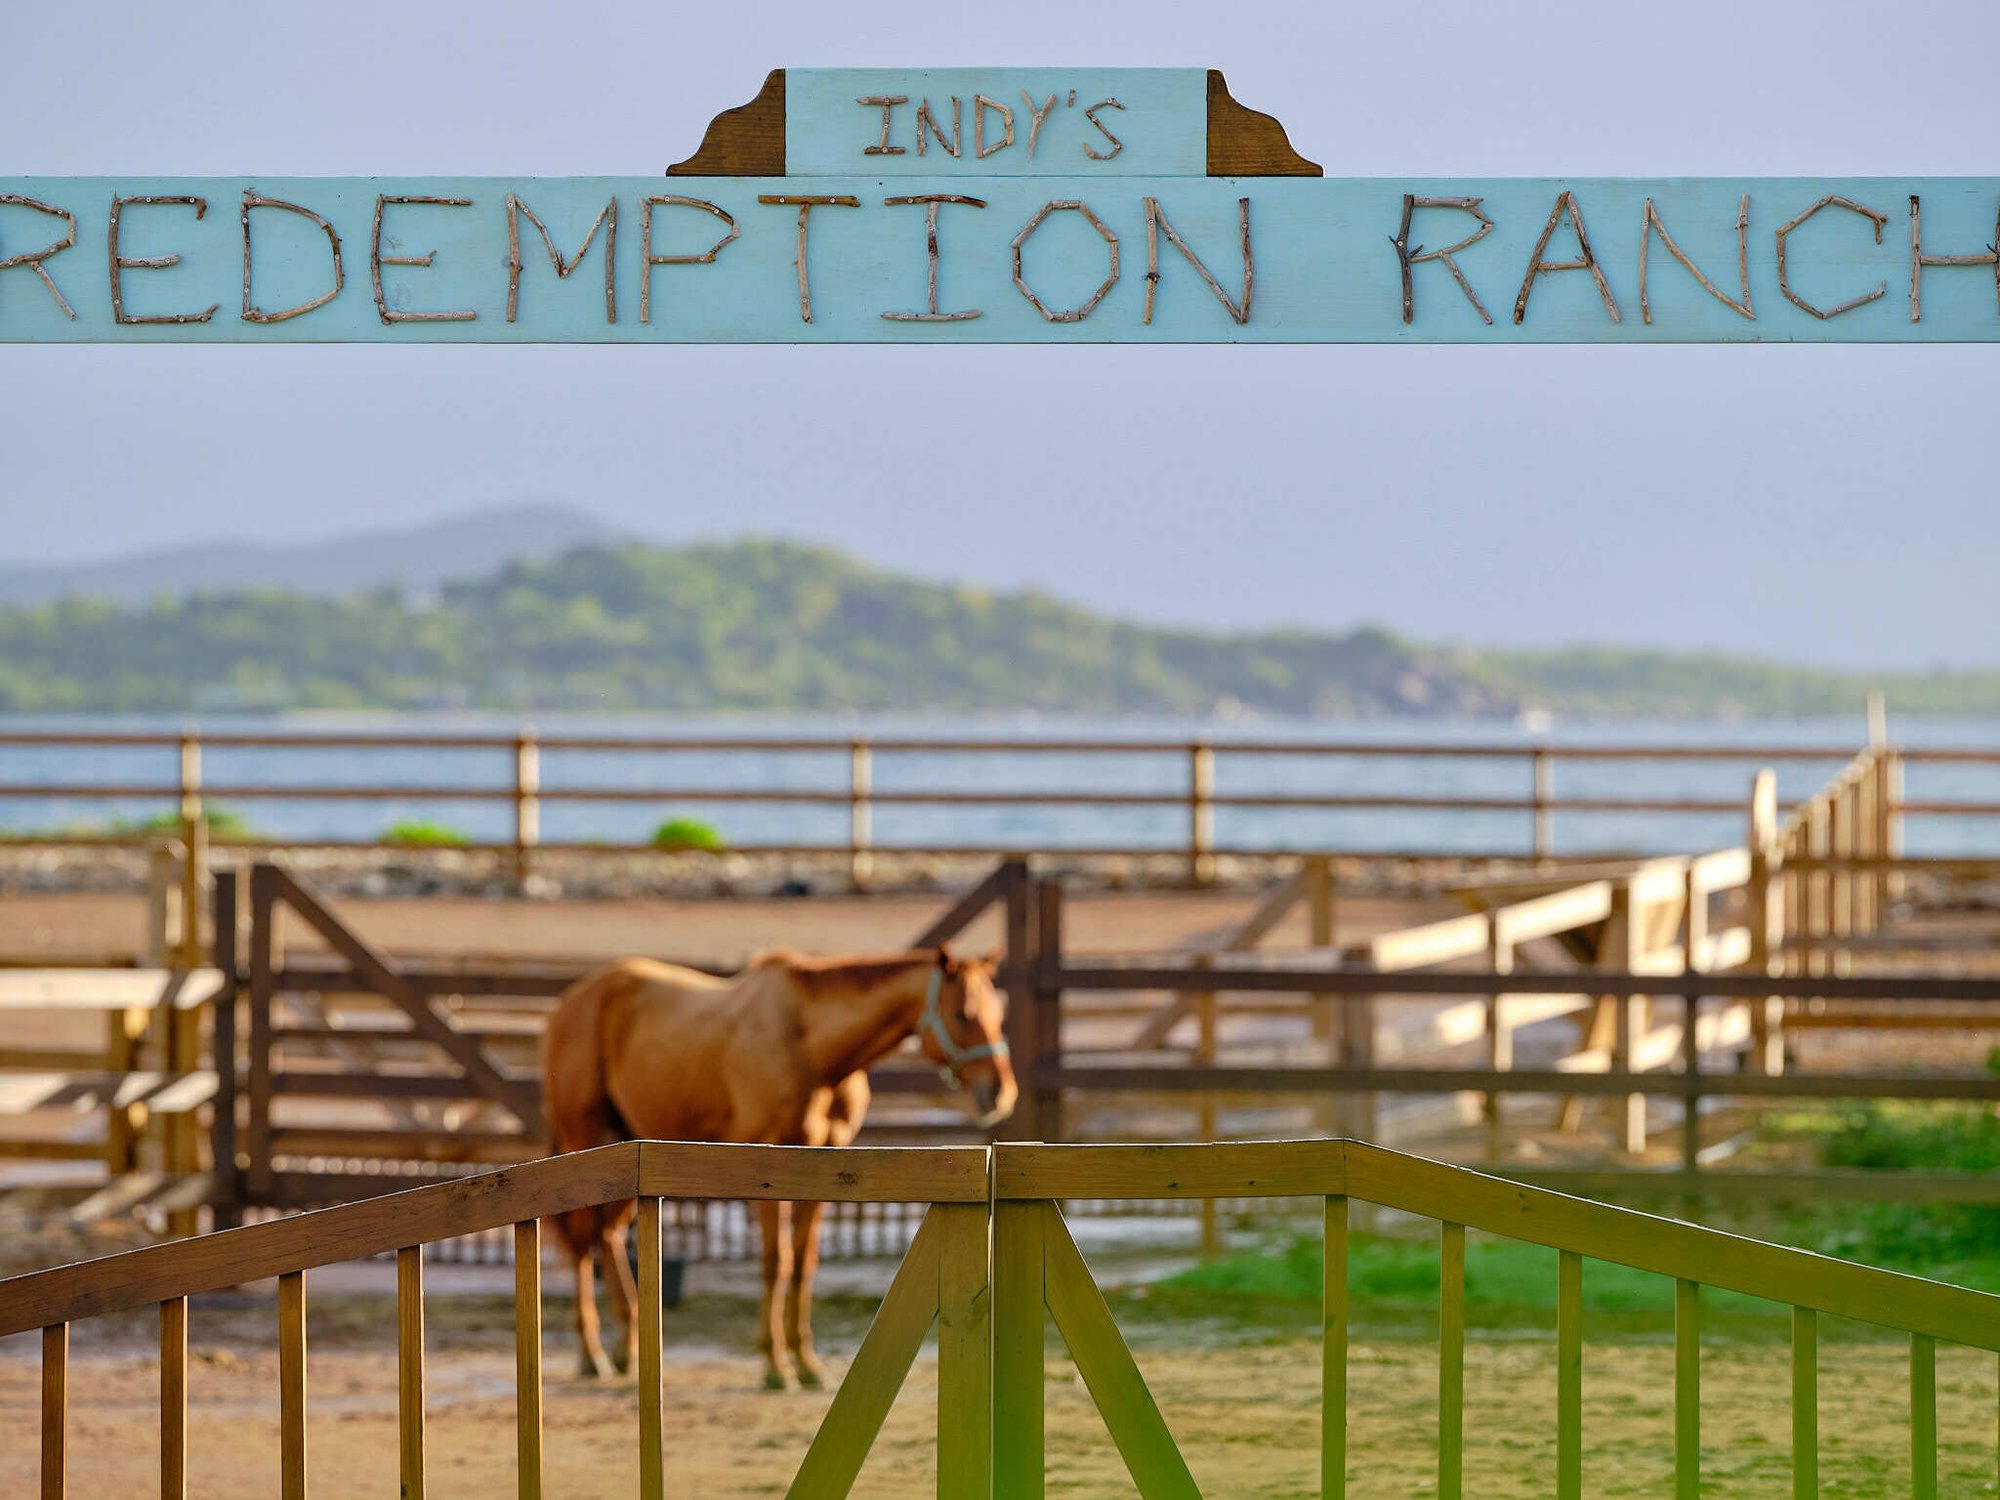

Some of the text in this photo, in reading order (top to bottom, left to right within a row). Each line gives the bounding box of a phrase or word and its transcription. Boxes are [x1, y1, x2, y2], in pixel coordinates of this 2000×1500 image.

[855, 88, 1126, 163] INDY'S
[0, 189, 2000, 325] REDEMPTION RANCH
